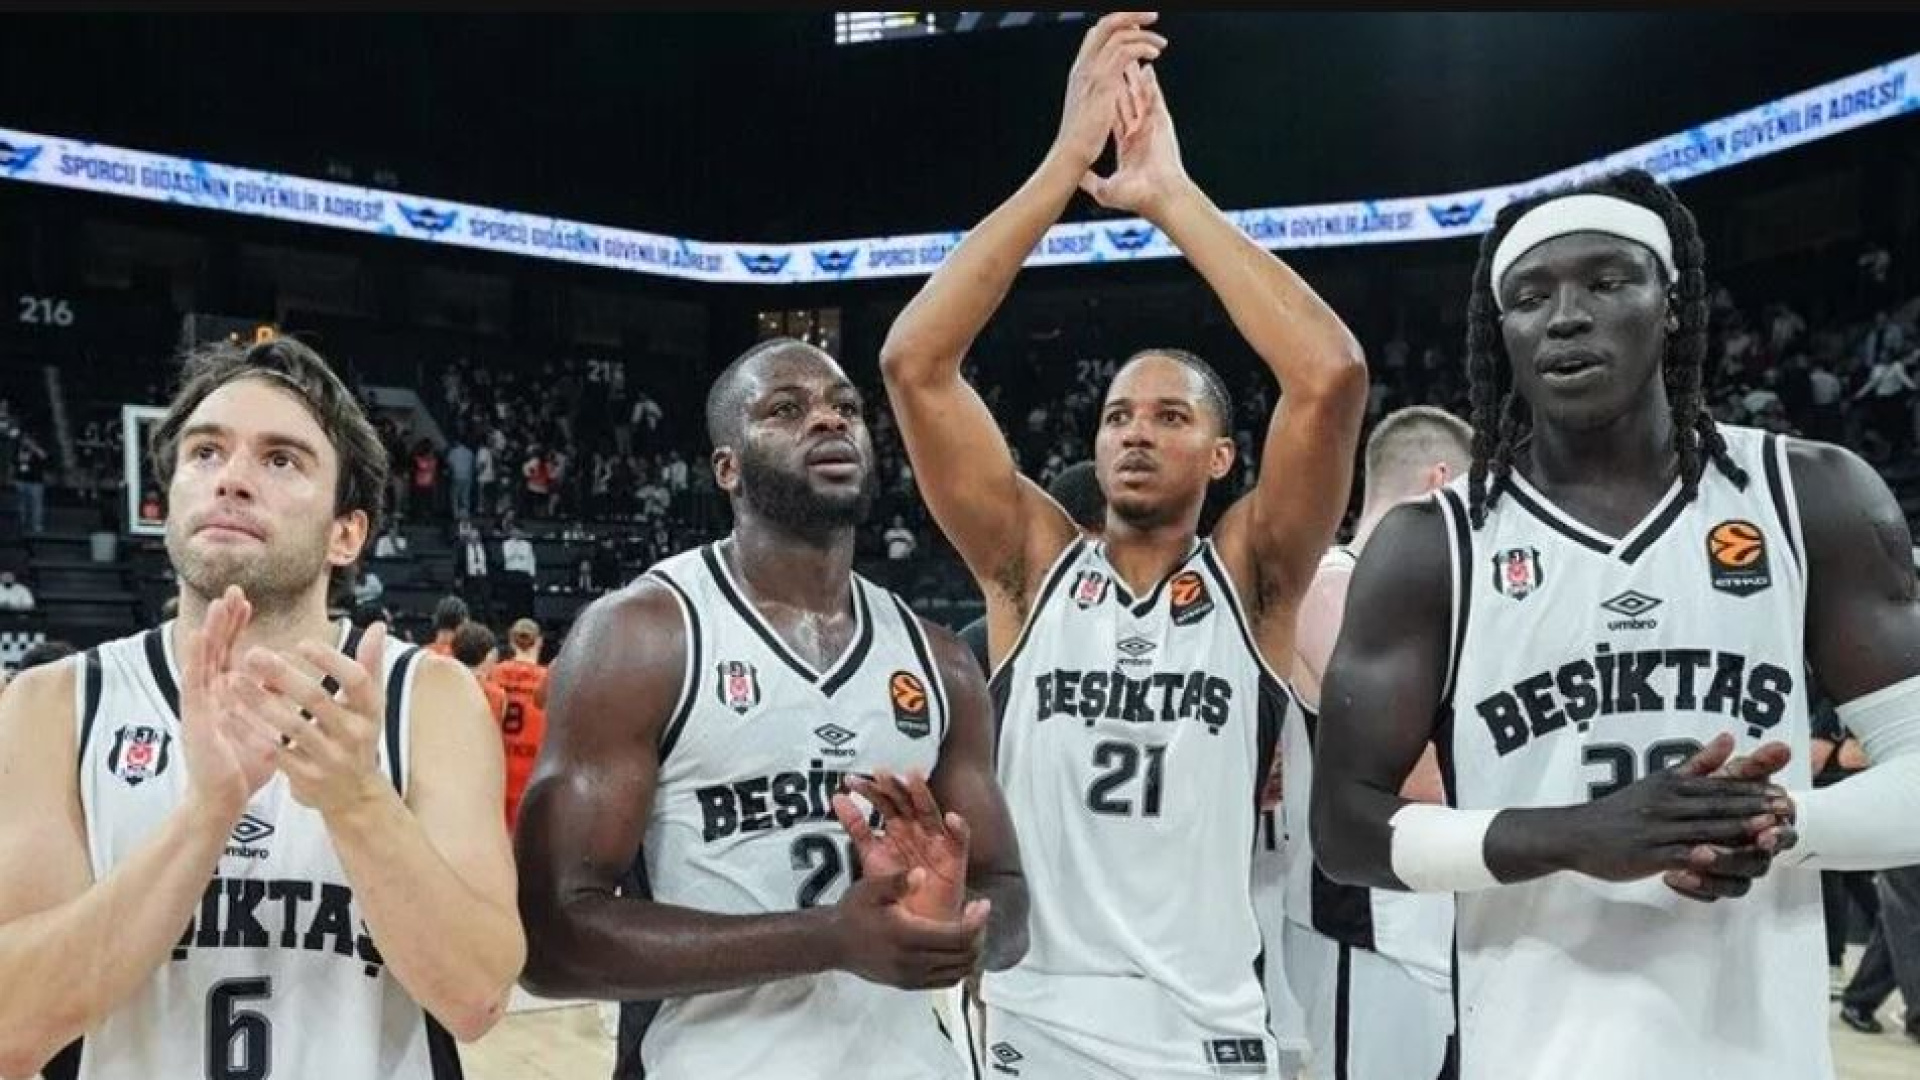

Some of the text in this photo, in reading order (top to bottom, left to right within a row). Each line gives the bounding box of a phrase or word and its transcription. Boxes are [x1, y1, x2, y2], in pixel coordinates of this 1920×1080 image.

[19, 295, 74, 326] 216
[1607, 618, 1658, 632] umbro
[503, 702, 525, 735] 8
[1475, 642, 1793, 757] BEŞİKTAŞ
[1086, 740, 1168, 818] 21
[205, 975, 273, 1080] 6
